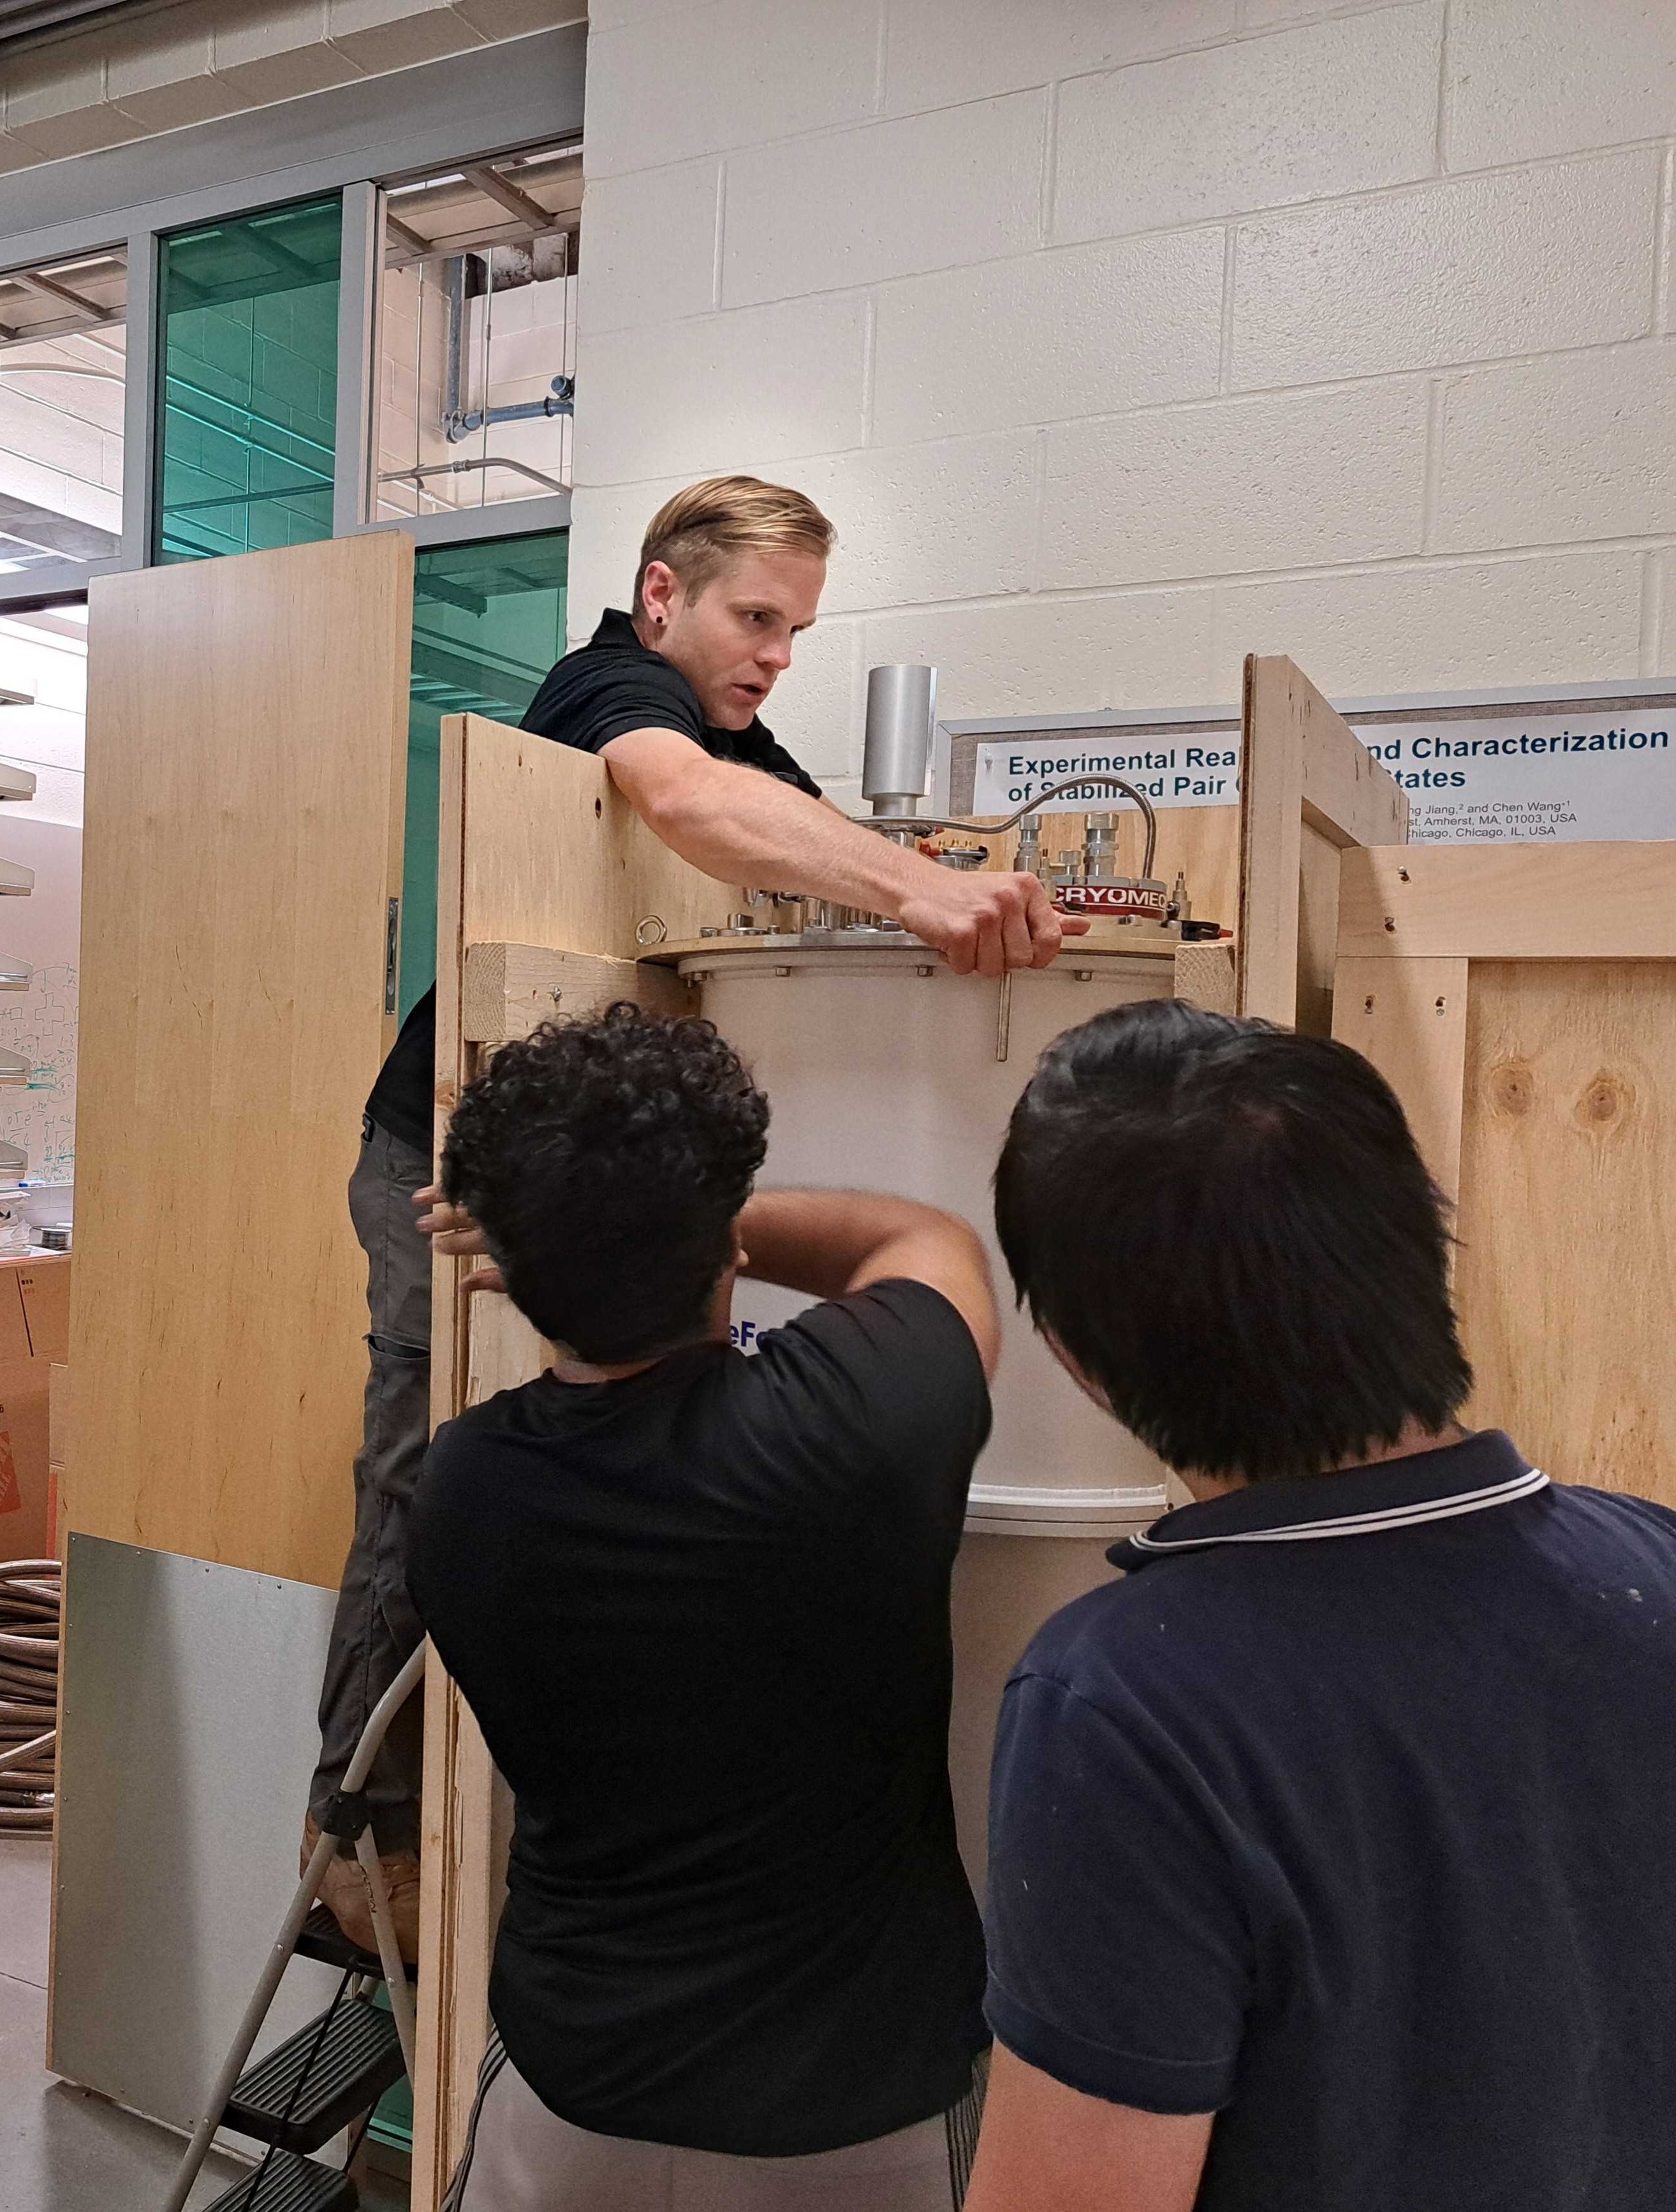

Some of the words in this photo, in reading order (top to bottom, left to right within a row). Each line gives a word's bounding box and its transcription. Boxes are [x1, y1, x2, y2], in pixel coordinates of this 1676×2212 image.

[1009, 749, 1175, 778] Experimental
[1186, 748, 1236, 767] Rea
[1367, 739, 1401, 760] nd
[1411, 728, 1669, 759] Characterization
[1008, 783, 1033, 802] of
[1174, 776, 1226, 797] Pair
[1385, 769, 1466, 788] tates
[1467, 804, 1489, 813] and
[1492, 803, 1523, 812] Chen
[1424, 816, 1474, 826] Amherst,
[1480, 815, 1501, 825] MA,
[1506, 814, 1546, 824] 01003,
[1550, 813, 1577, 823] USA
[1409, 829, 1452, 839] hicago,
[1455, 828, 1506, 839] Chicago,
[1511, 826, 1524, 836] IL,
[1529, 826, 1556, 836] USA
